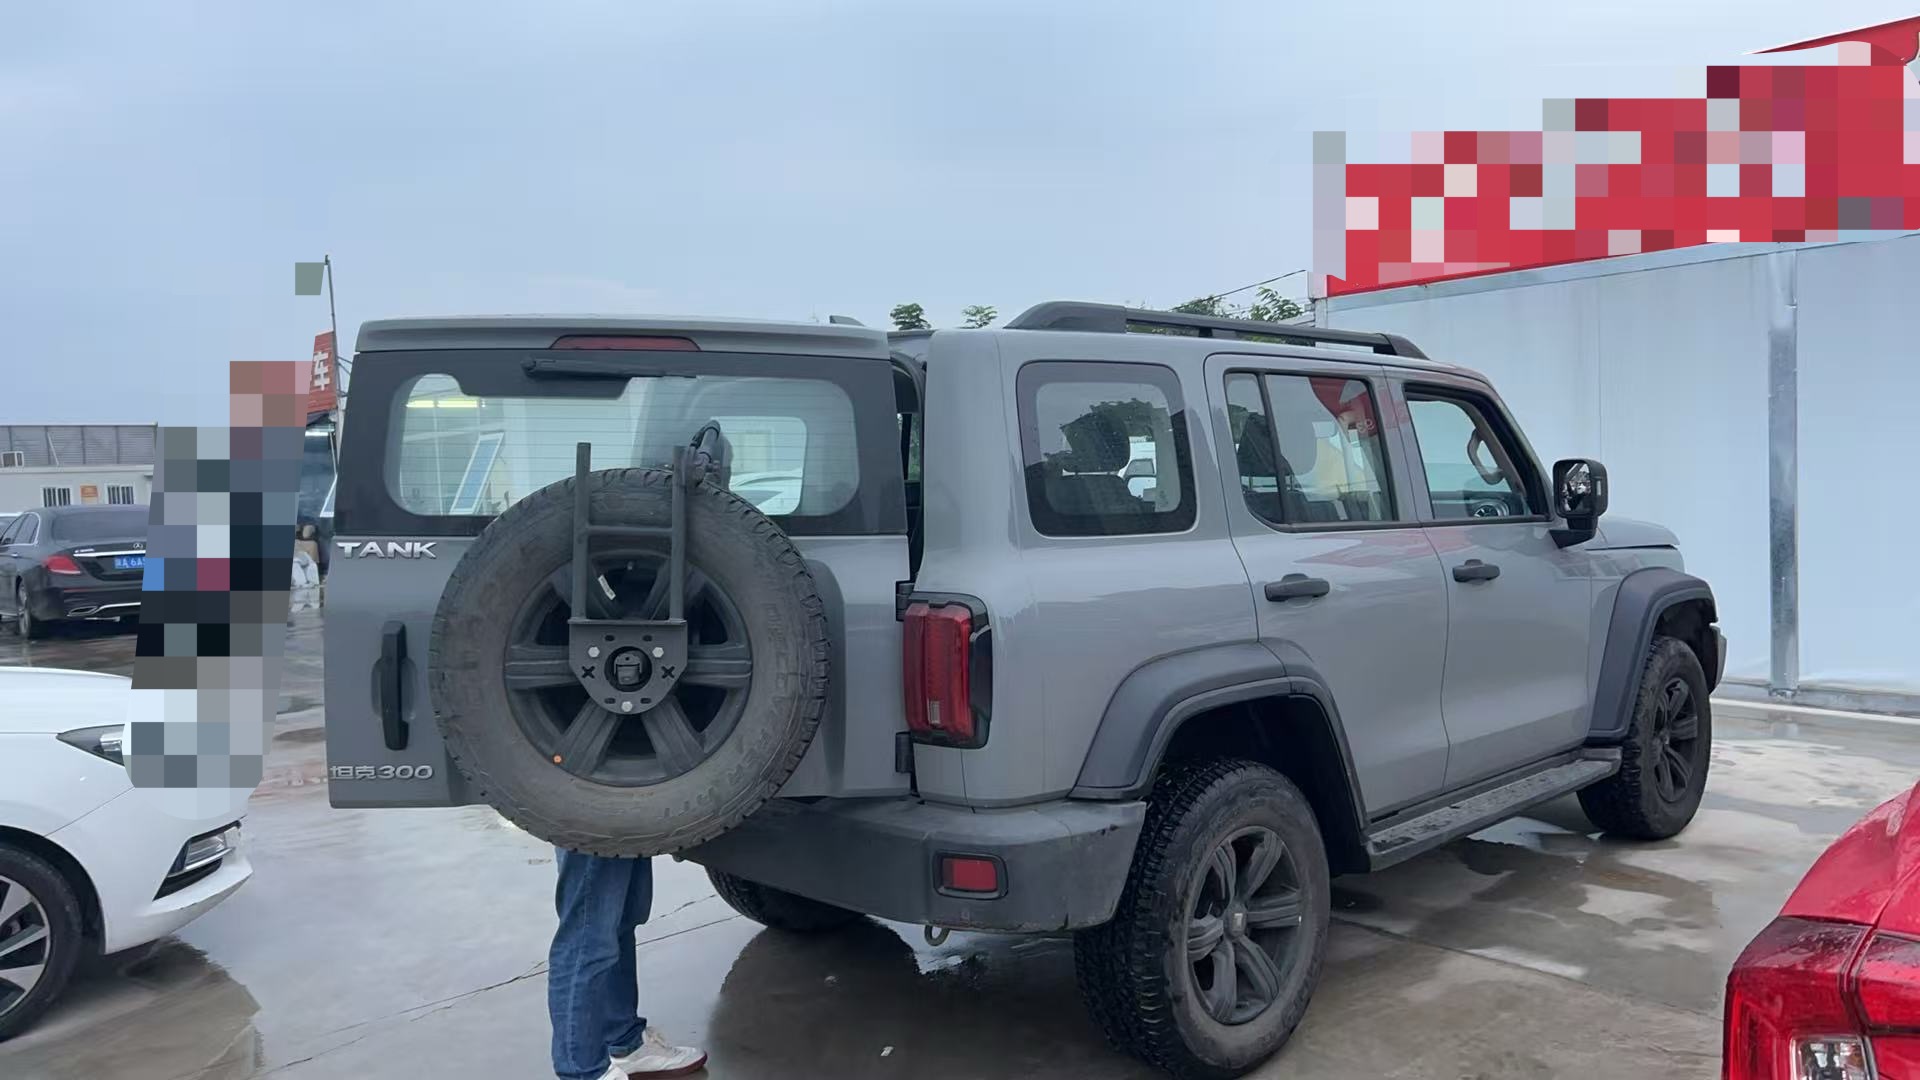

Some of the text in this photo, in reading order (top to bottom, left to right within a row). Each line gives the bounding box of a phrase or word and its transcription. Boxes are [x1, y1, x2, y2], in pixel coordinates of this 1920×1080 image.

[312, 351, 331, 392] 车
[336, 541, 437, 559] TANK
[329, 765, 433, 780] 坦克300
